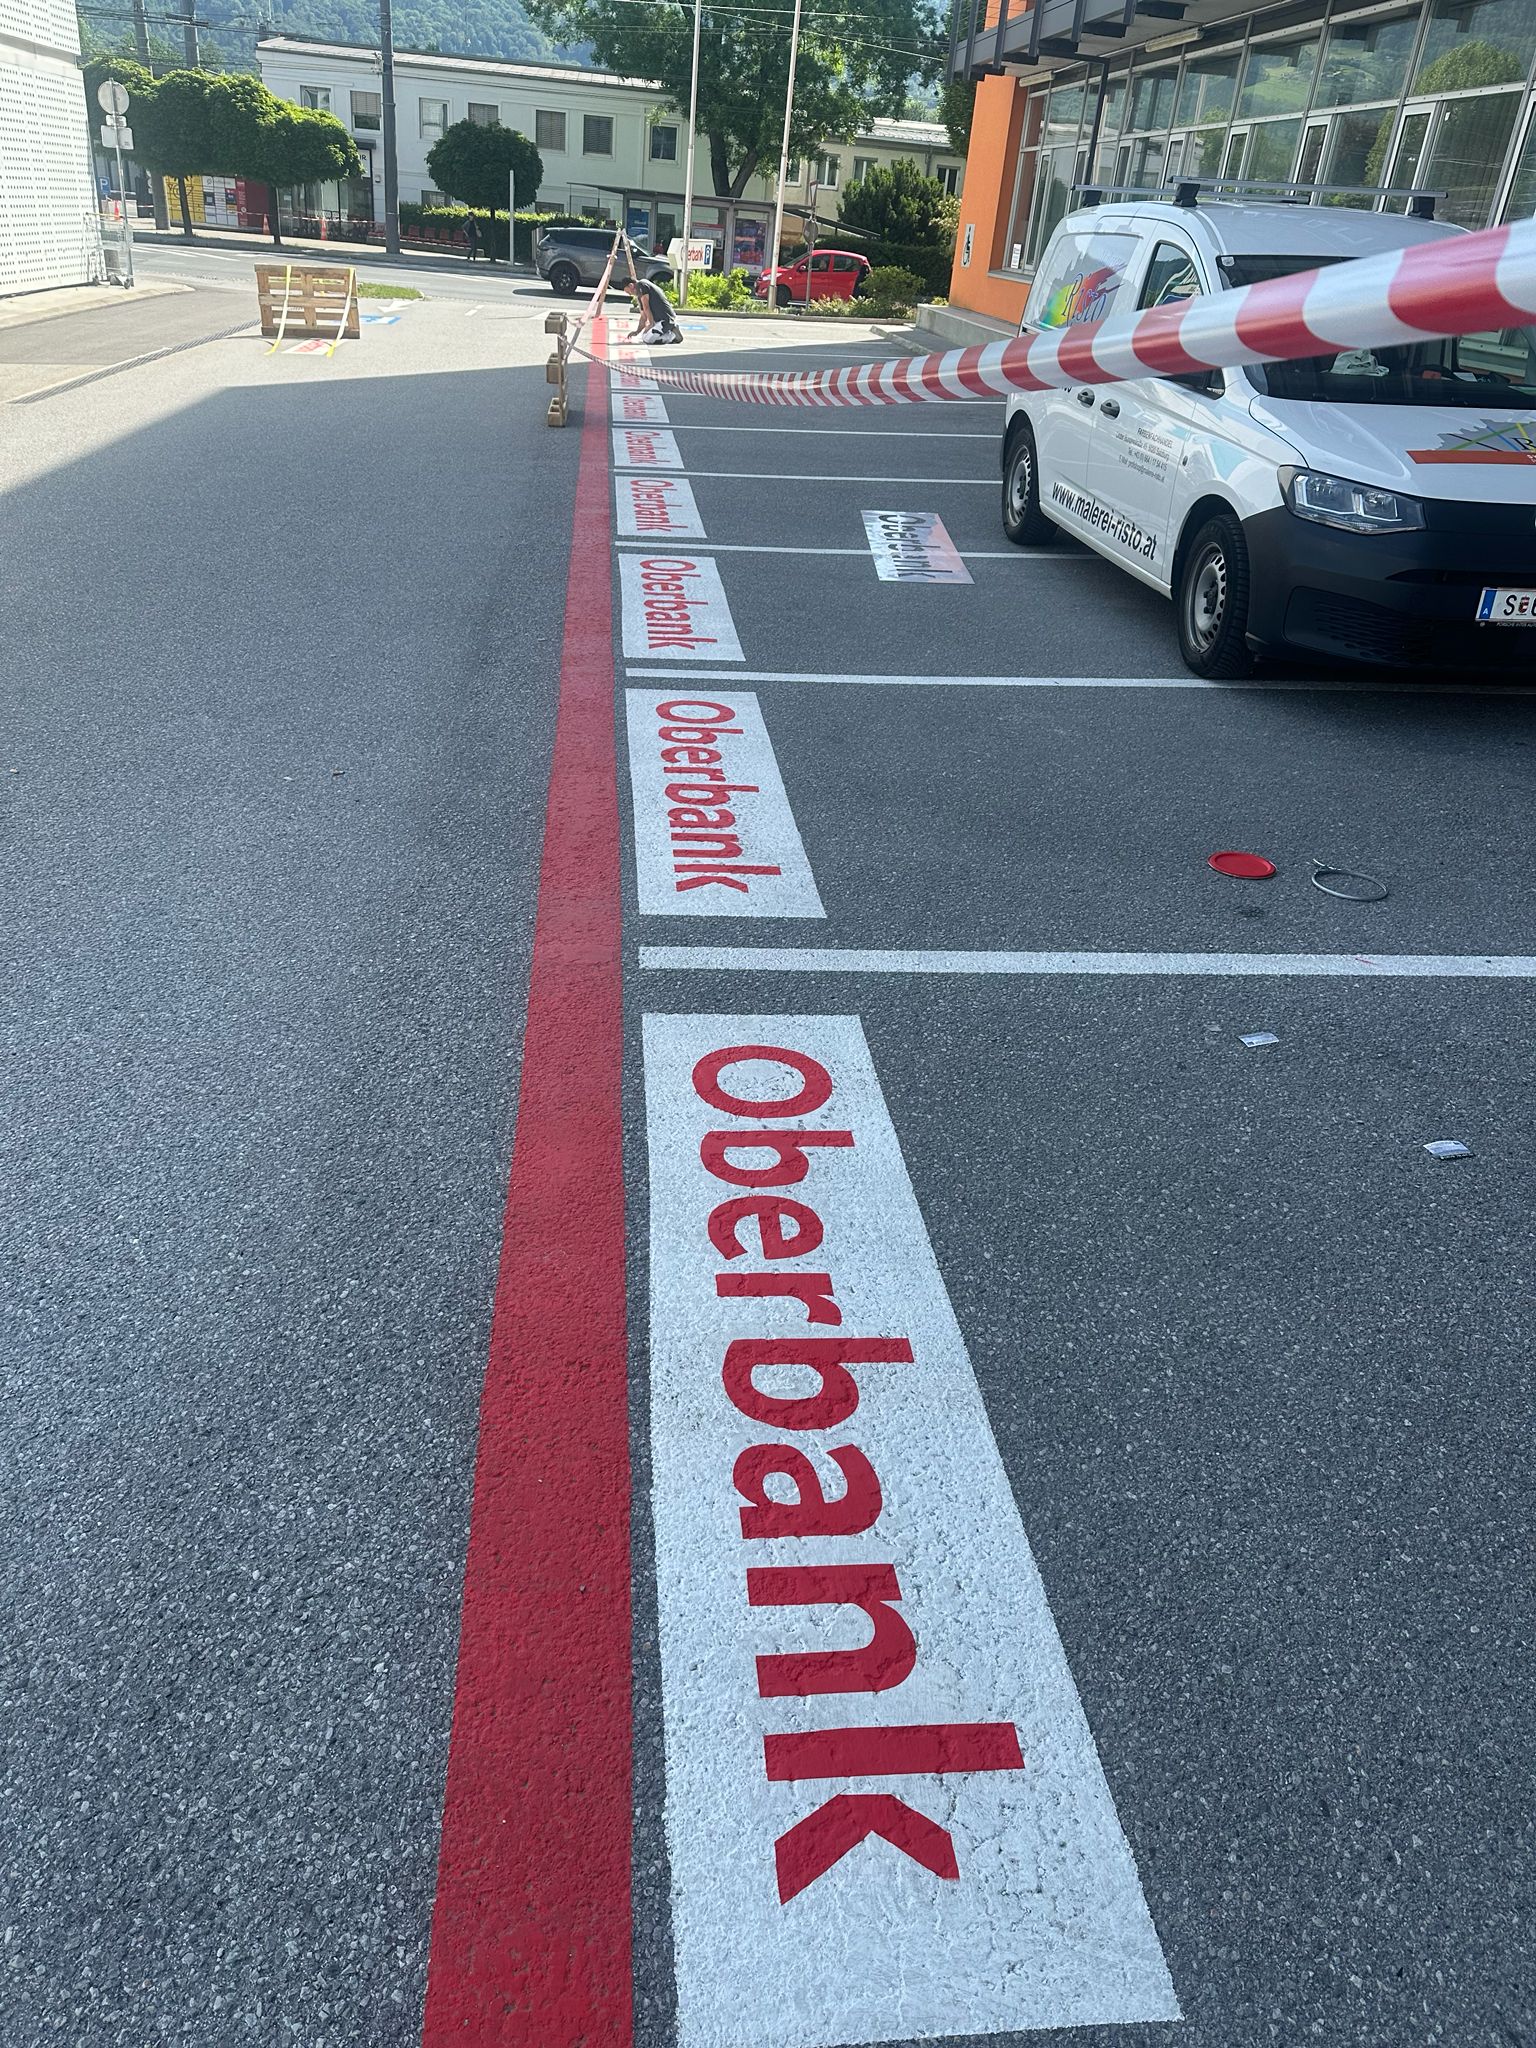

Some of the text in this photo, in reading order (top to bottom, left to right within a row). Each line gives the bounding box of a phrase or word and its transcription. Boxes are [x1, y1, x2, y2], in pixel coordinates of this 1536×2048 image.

[624, 431, 671, 464] Oberbank
[630, 479, 688, 532] Oberbank
[1052, 482, 1157, 560] www.malerei-risto.at
[879, 514, 952, 578] Oberbank
[639, 559, 717, 650] Oberbank
[656, 700, 781, 893] Oberbank
[691, 1045, 1025, 1905] Oberbank
